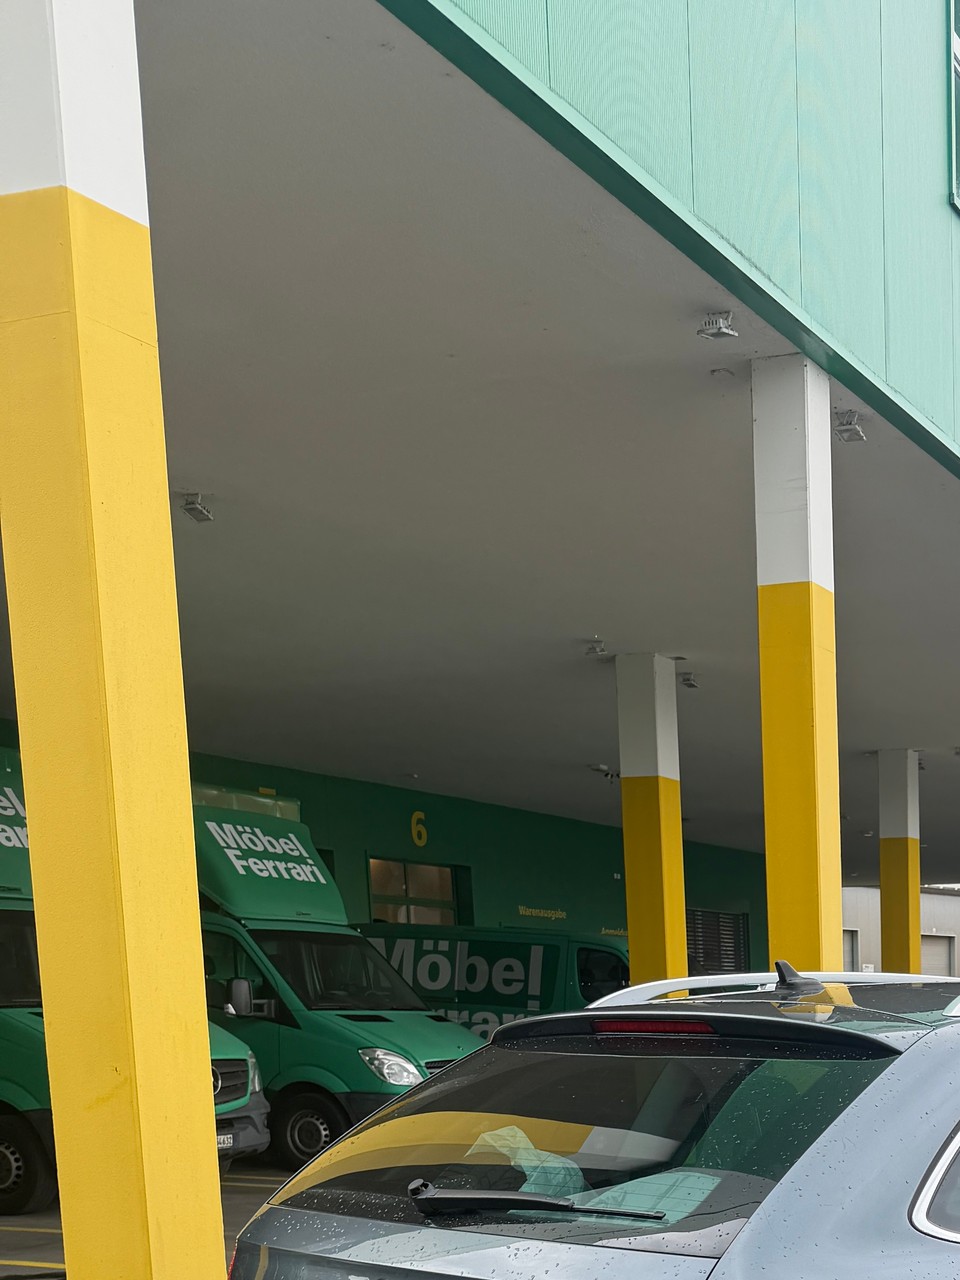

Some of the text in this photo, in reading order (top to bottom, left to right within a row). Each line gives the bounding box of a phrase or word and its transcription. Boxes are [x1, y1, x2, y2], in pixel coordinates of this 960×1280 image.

[205, 821, 309, 858] Möbel
[411, 811, 428, 847] 6
[224, 848, 327, 884] Ferrari
[518, 905, 567, 920] Warenausgabe
[363, 937, 544, 996] Möbel
